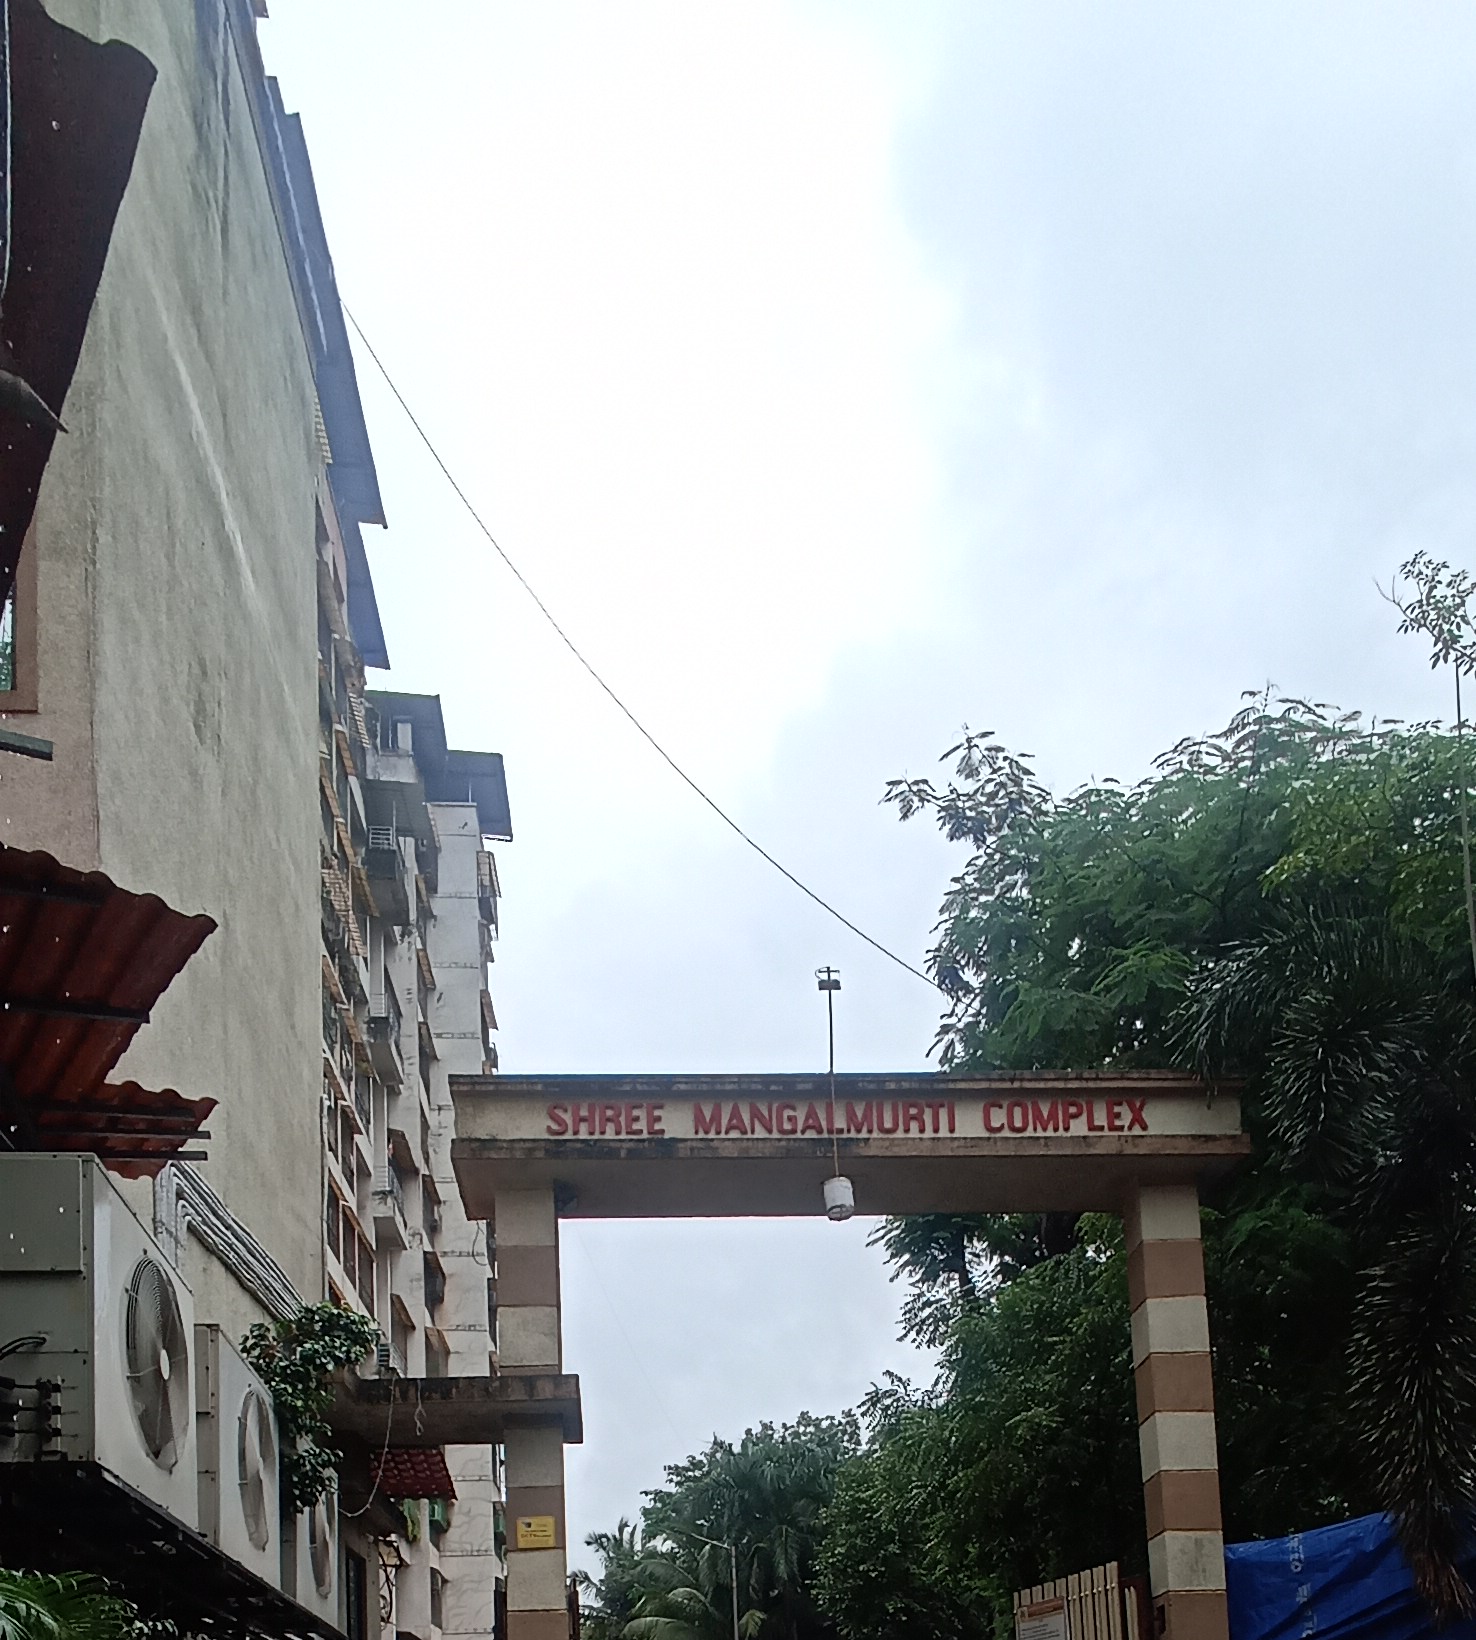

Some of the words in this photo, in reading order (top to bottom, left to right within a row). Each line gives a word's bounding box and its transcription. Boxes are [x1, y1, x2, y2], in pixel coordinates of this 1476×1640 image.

[545, 1103, 665, 1136] SHREE
[693, 1101, 957, 1135] MANGALMURTI
[983, 1098, 1150, 1134] COMPLEX
